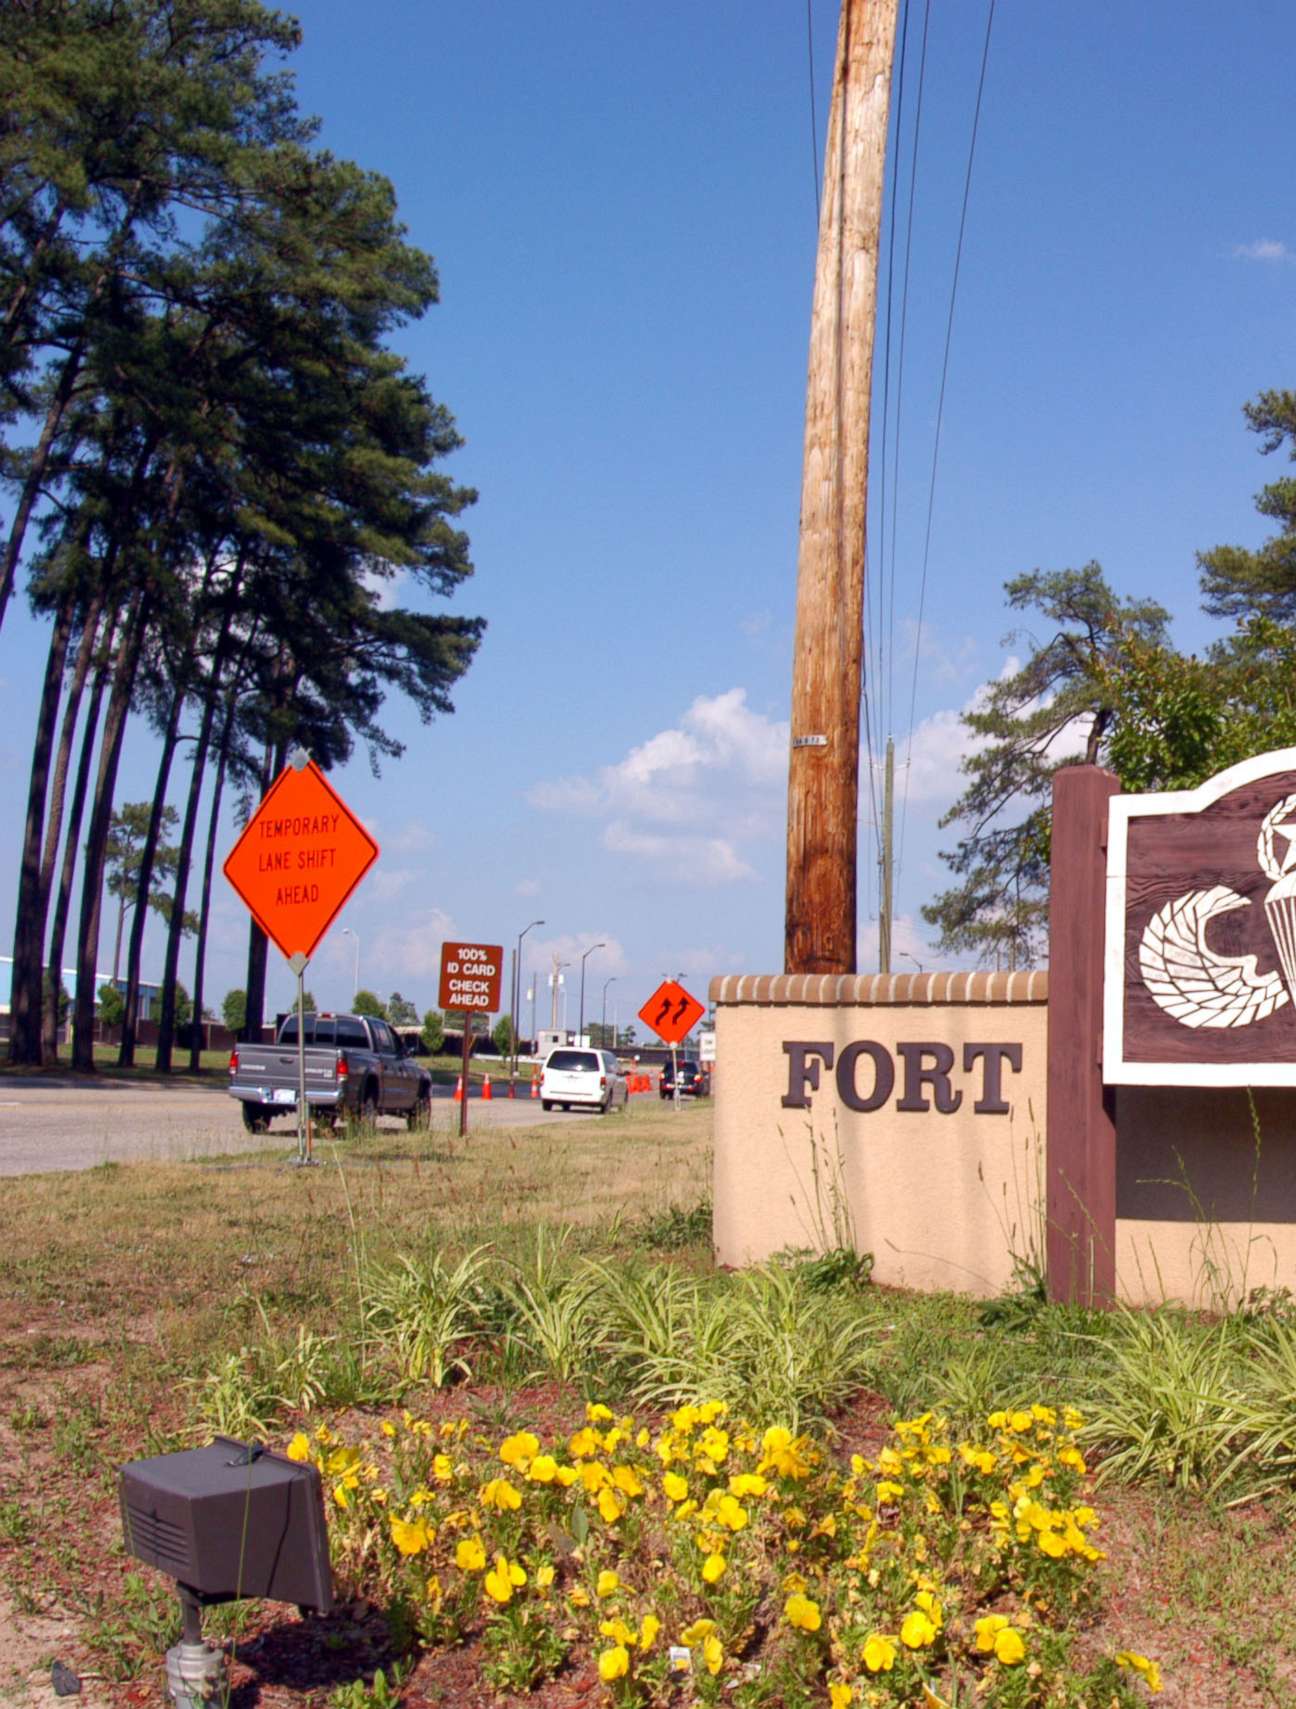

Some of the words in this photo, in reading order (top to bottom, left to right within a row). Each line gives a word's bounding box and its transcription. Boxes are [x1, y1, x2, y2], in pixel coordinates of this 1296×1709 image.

[259, 814, 339, 838] TEMPORARY
[258, 851, 291, 872] LANE
[297, 848, 336, 870] SHIFT
[276, 884, 319, 906] AHEAD
[457, 948, 488, 961] 100%
[447, 962, 460, 974] ID
[462, 963, 496, 977] CARD
[448, 979, 490, 993] CHECK
[448, 993, 489, 1007] AHEAD
[781, 1040, 1022, 1115] FORT
